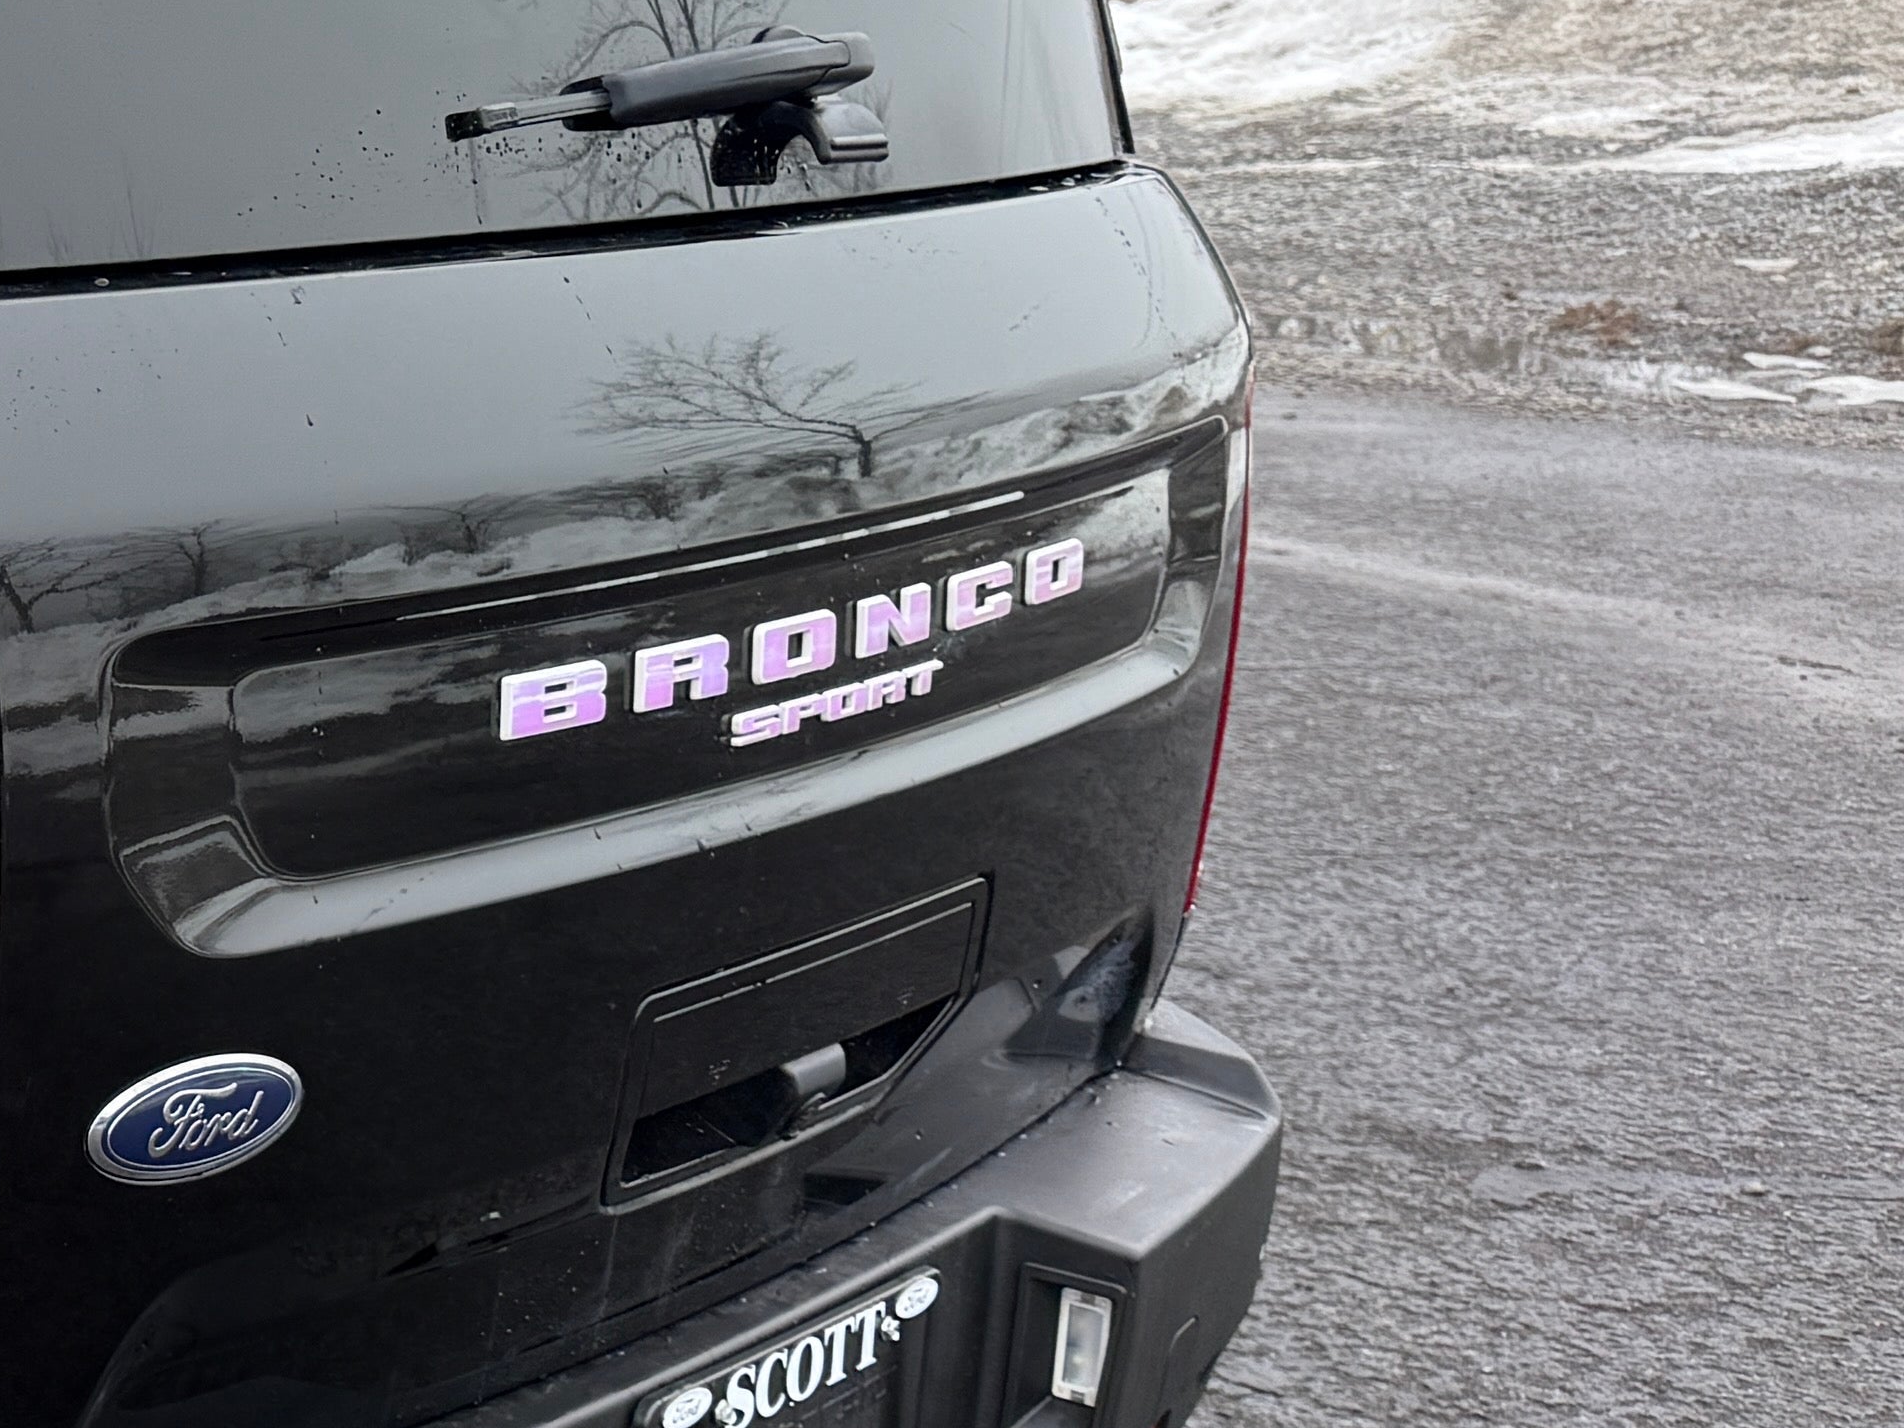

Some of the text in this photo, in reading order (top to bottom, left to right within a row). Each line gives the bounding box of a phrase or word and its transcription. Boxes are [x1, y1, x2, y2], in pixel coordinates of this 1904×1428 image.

[500, 538, 1084, 741] BRONCO
[730, 660, 943, 747] SPORT
[148, 1083, 264, 1158] Ford
